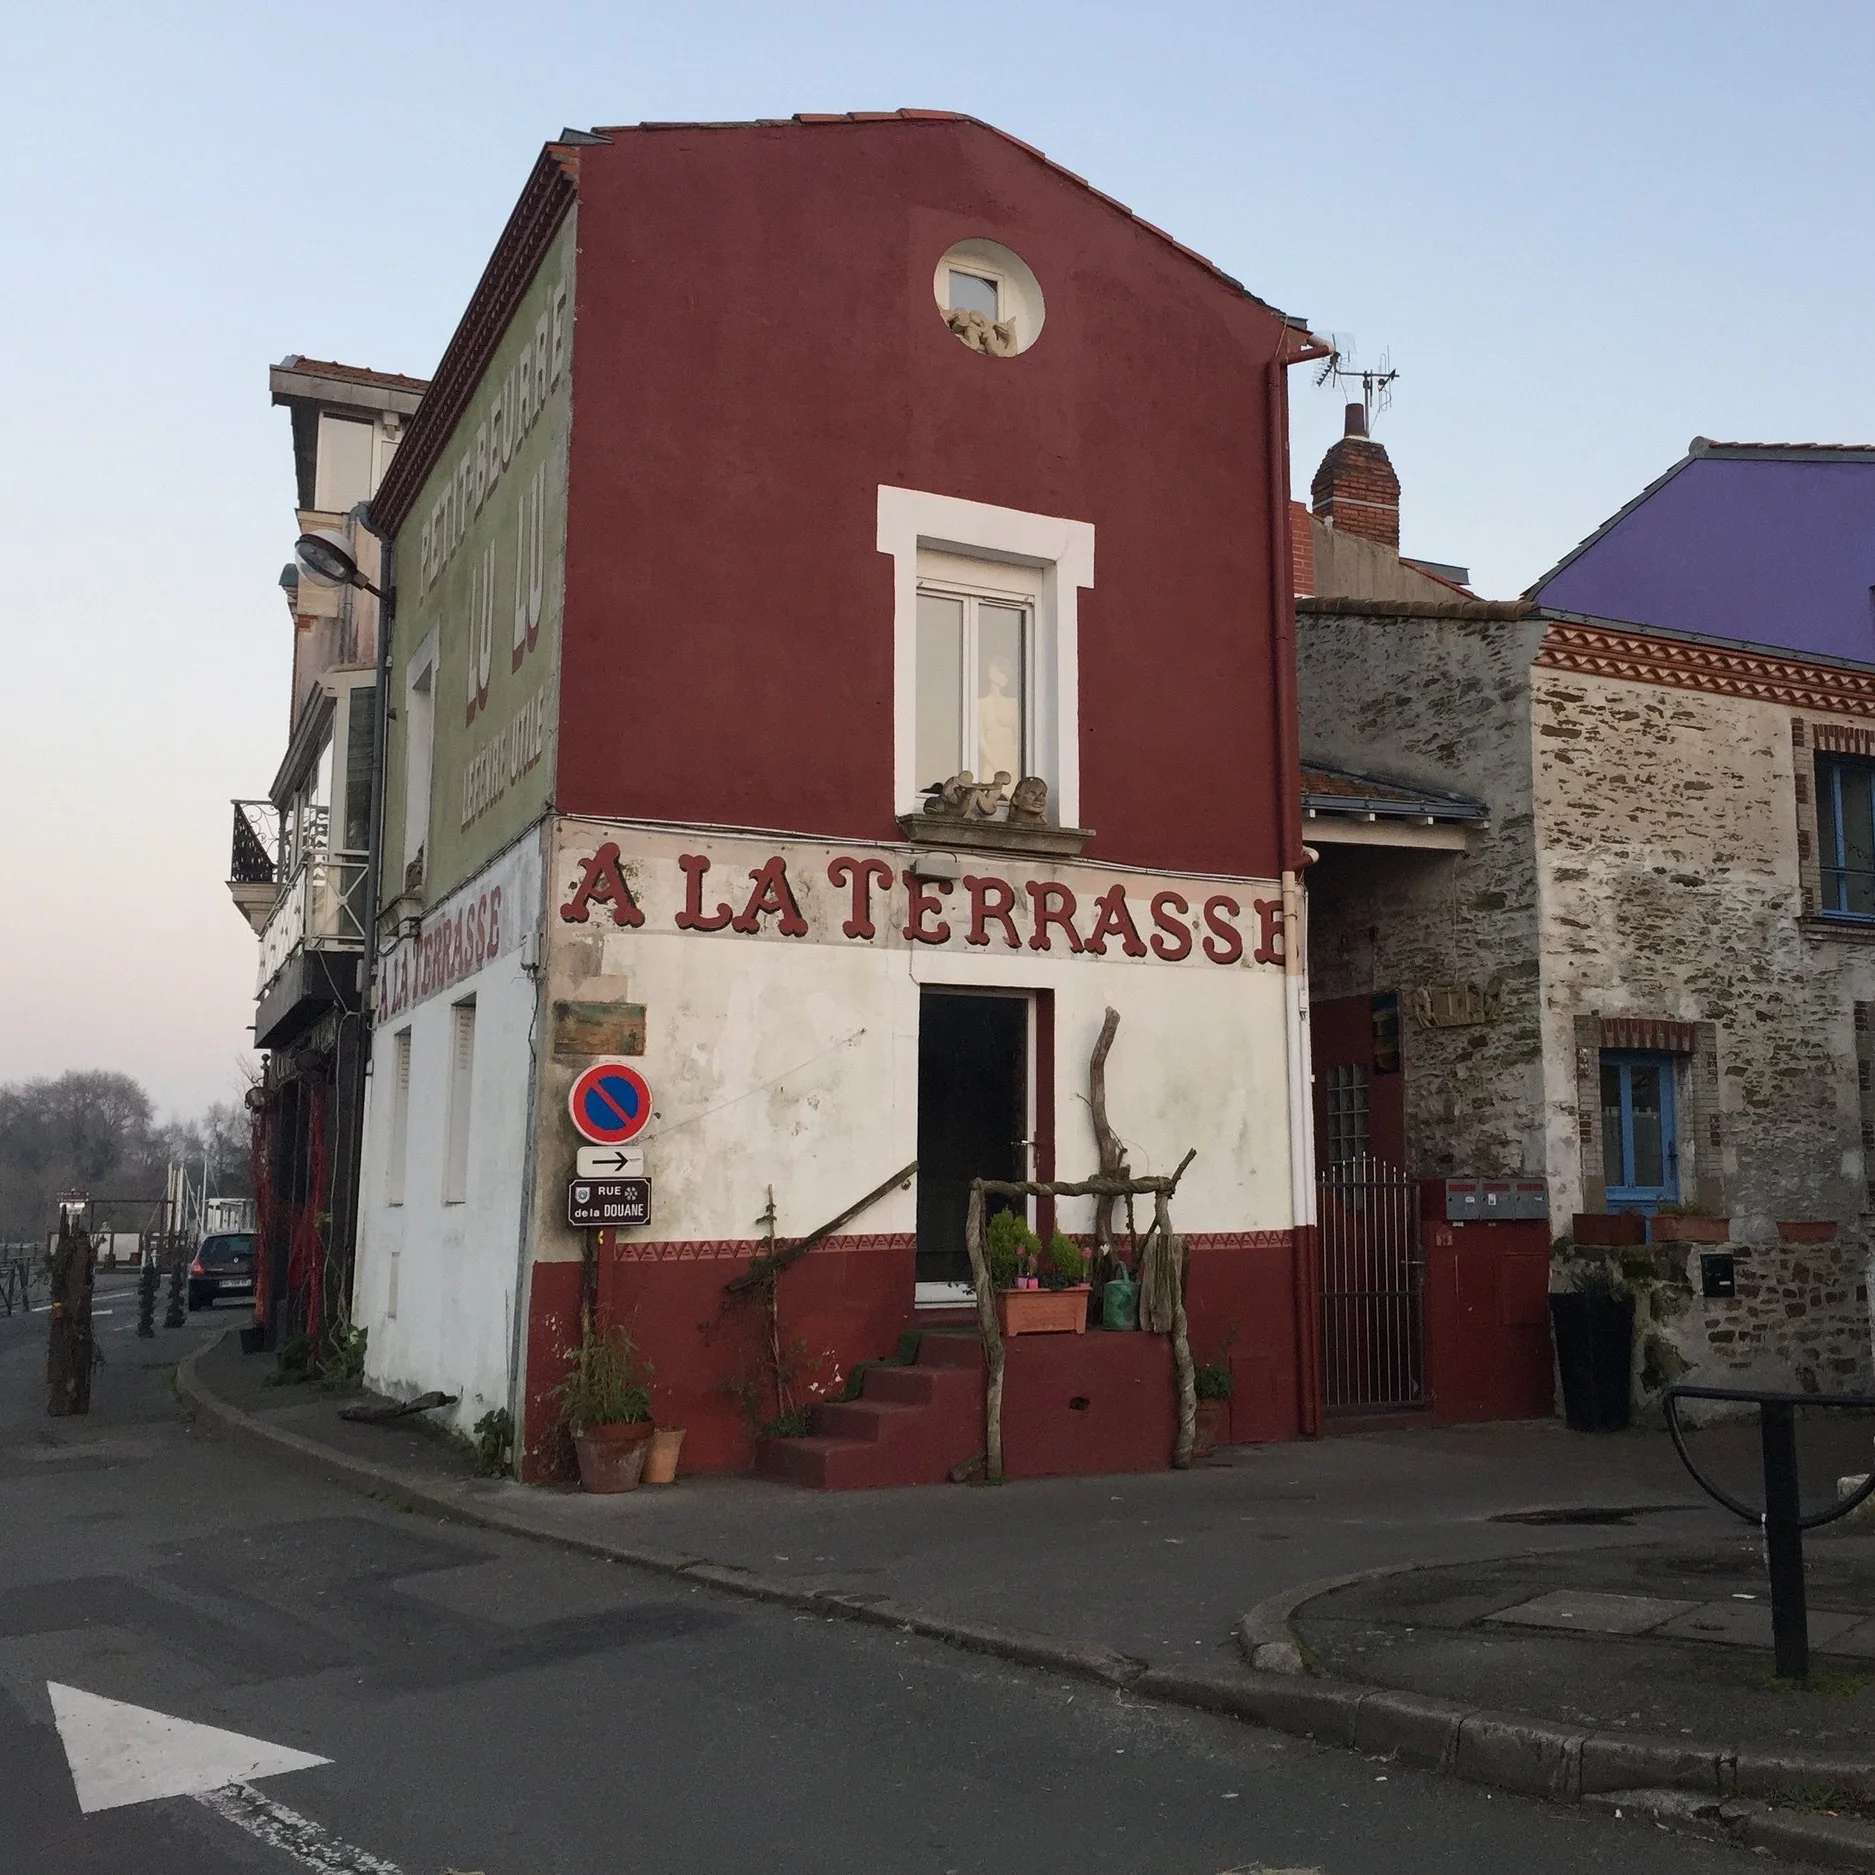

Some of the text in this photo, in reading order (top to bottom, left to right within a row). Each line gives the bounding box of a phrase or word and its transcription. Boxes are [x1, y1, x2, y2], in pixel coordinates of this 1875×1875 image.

[465, 457, 546, 728] LU LU
[509, 684, 545, 787] UTILE
[377, 885, 502, 1024] A LA TERRASSE
[560, 841, 1287, 966] A LA TERRASSE
[574, 1203, 644, 1218] de la DOUANE
[598, 1186, 622, 1196] RUE
